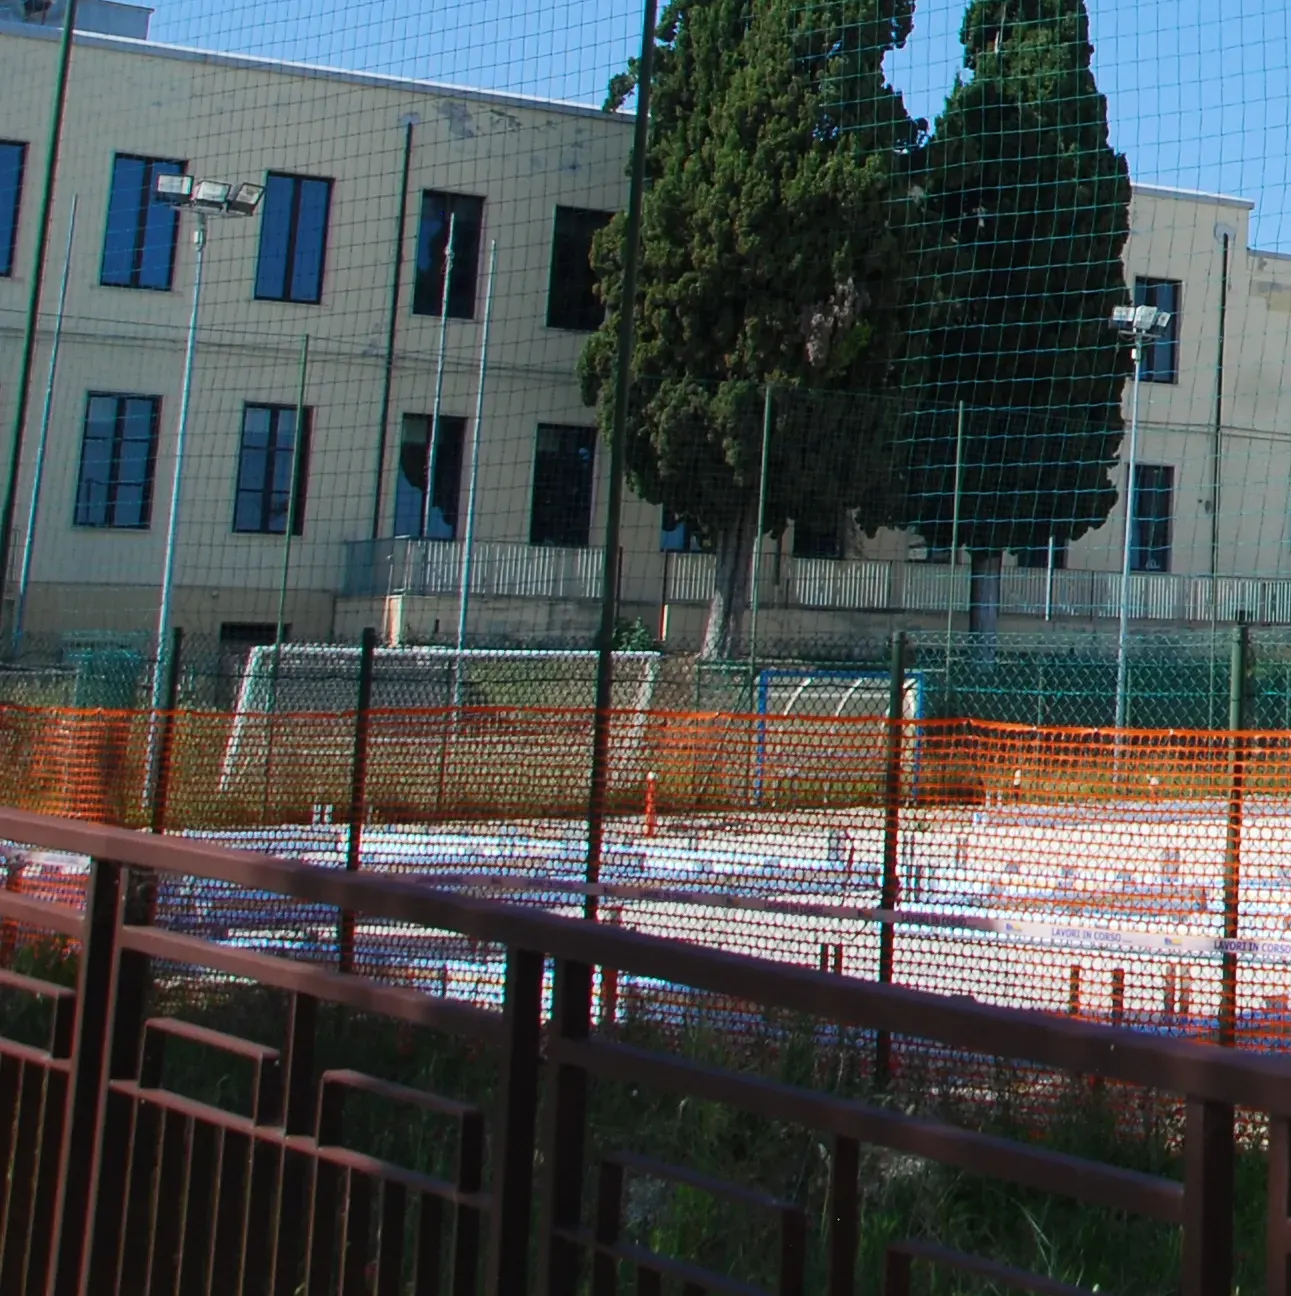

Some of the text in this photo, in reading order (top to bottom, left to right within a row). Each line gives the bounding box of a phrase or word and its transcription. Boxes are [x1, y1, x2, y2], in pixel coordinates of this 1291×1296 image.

[1051, 927, 1080, 938] LAVORI
[1094, 930, 1122, 942] CORSO
[1214, 939, 1291, 954] LAVORI IN CORSO
